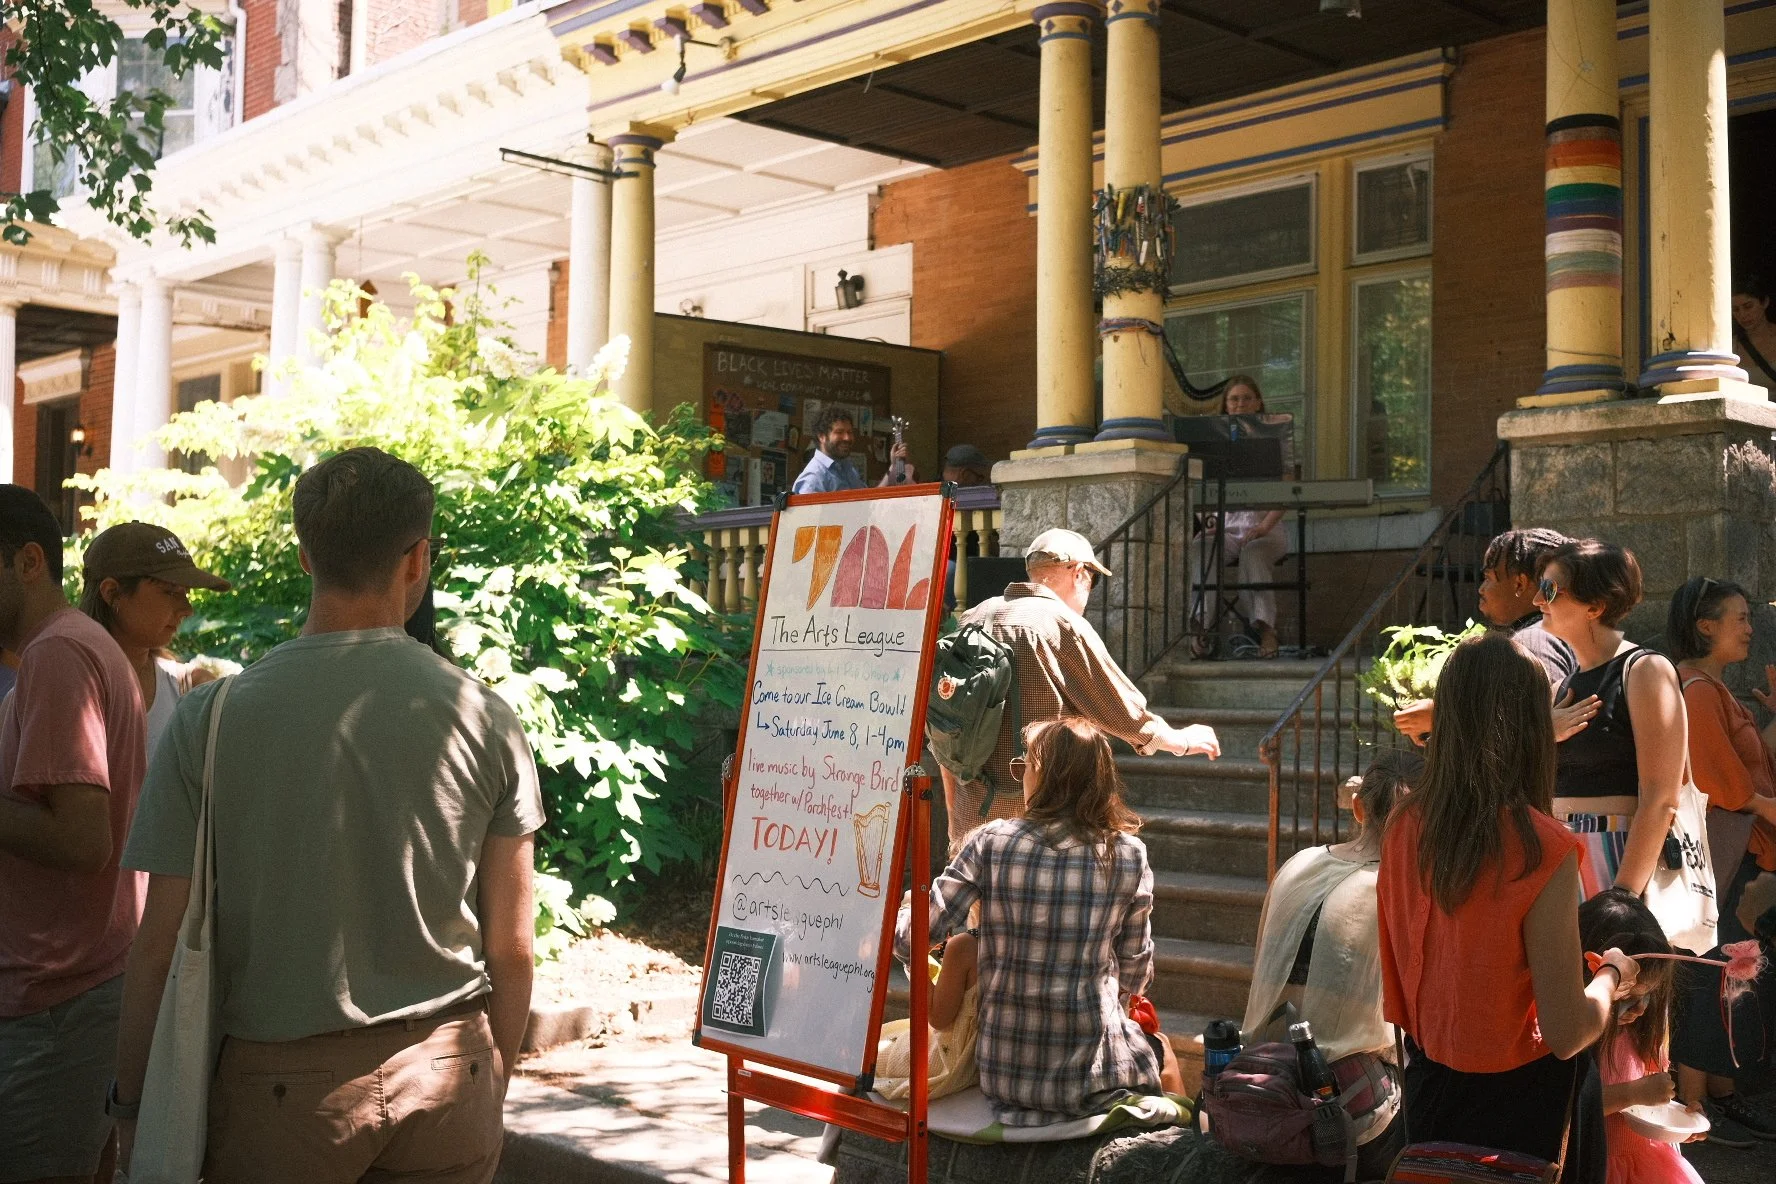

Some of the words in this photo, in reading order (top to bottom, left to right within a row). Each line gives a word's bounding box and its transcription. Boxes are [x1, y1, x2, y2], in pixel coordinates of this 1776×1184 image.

[718, 351, 767, 376] BLACK
[773, 360, 814, 378] LIVES
[818, 367, 870, 384] MATTER
[156, 537, 179, 554] SAN
[770, 615, 799, 645] The
[802, 614, 838, 648] Arts
[845, 614, 905, 657] League
[752, 680, 780, 705] Come
[782, 685, 794, 702] to
[794, 691, 811, 704] our
[811, 682, 831, 706] Ice
[835, 685, 865, 710] Cream
[870, 690, 906, 716] Bowl!
[771, 715, 818, 746] Saturday
[821, 719, 845, 740] June
[849, 722, 859, 749] 8,
[865, 725, 905, 755] 1-4pm
[748, 748, 767, 774] live
[767, 760, 799, 777] music
[801, 760, 816, 789] by
[823, 755, 867, 799] Strange
[870, 760, 901, 793] Bird
[751, 783, 791, 809] together
[751, 816, 838, 865] TODAY!
[782, 951, 875, 993] wwwartsleaguephl.org
